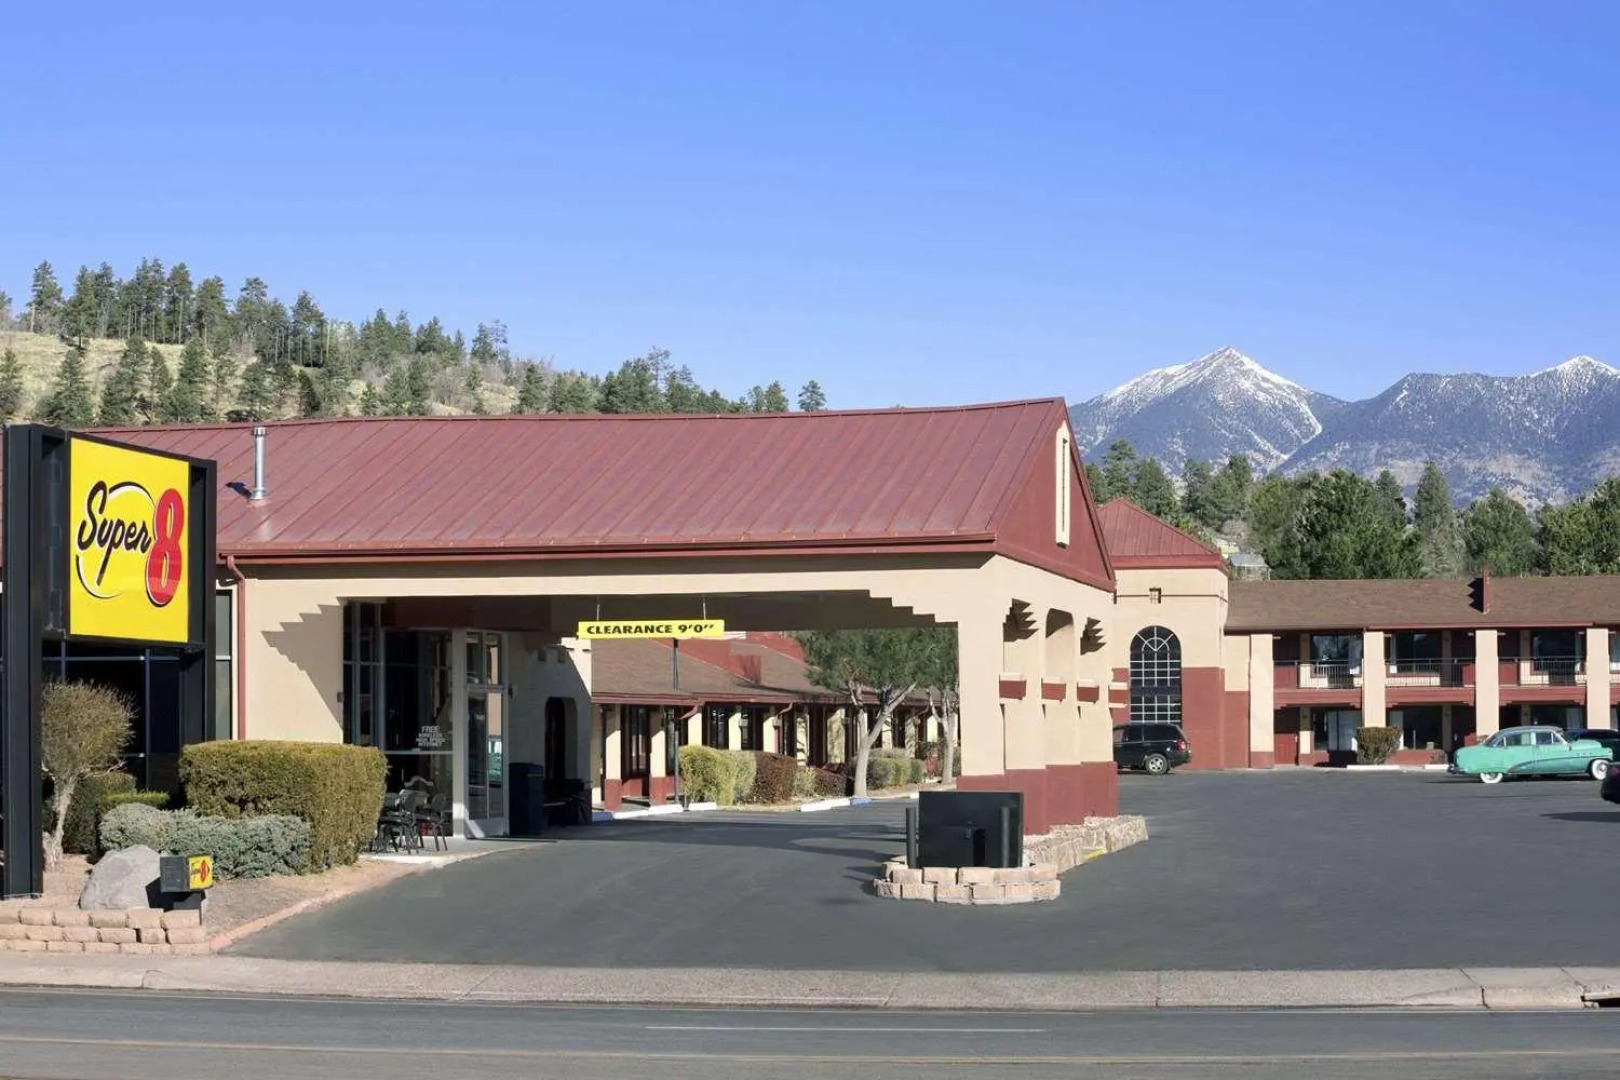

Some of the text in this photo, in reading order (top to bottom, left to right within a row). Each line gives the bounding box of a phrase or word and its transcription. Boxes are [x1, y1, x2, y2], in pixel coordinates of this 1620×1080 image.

[77, 480, 185, 608] Super 8
[587, 625, 673, 635] CLEARANCE
[421, 725, 440, 733] FREE
